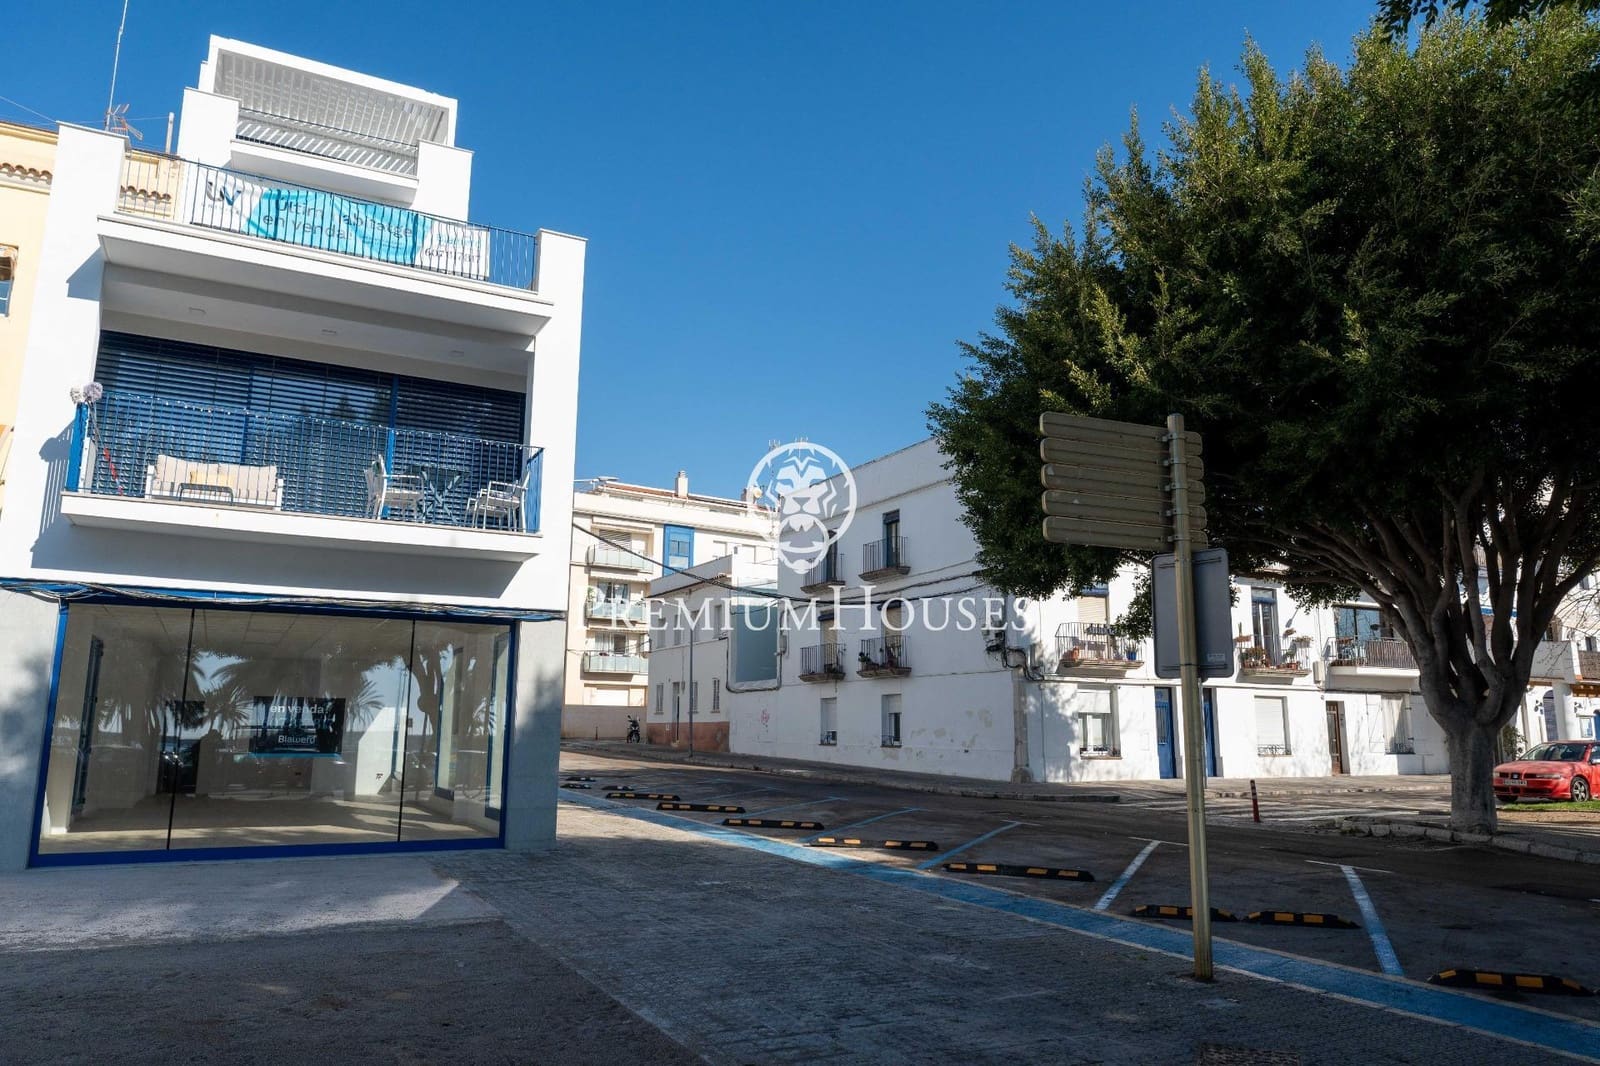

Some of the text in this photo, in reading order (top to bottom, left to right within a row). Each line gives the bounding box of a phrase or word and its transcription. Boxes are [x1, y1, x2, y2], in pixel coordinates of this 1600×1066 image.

[263, 215, 285, 228] en
[335, 209, 412, 239] abtatge
[270, 705, 285, 713] en
